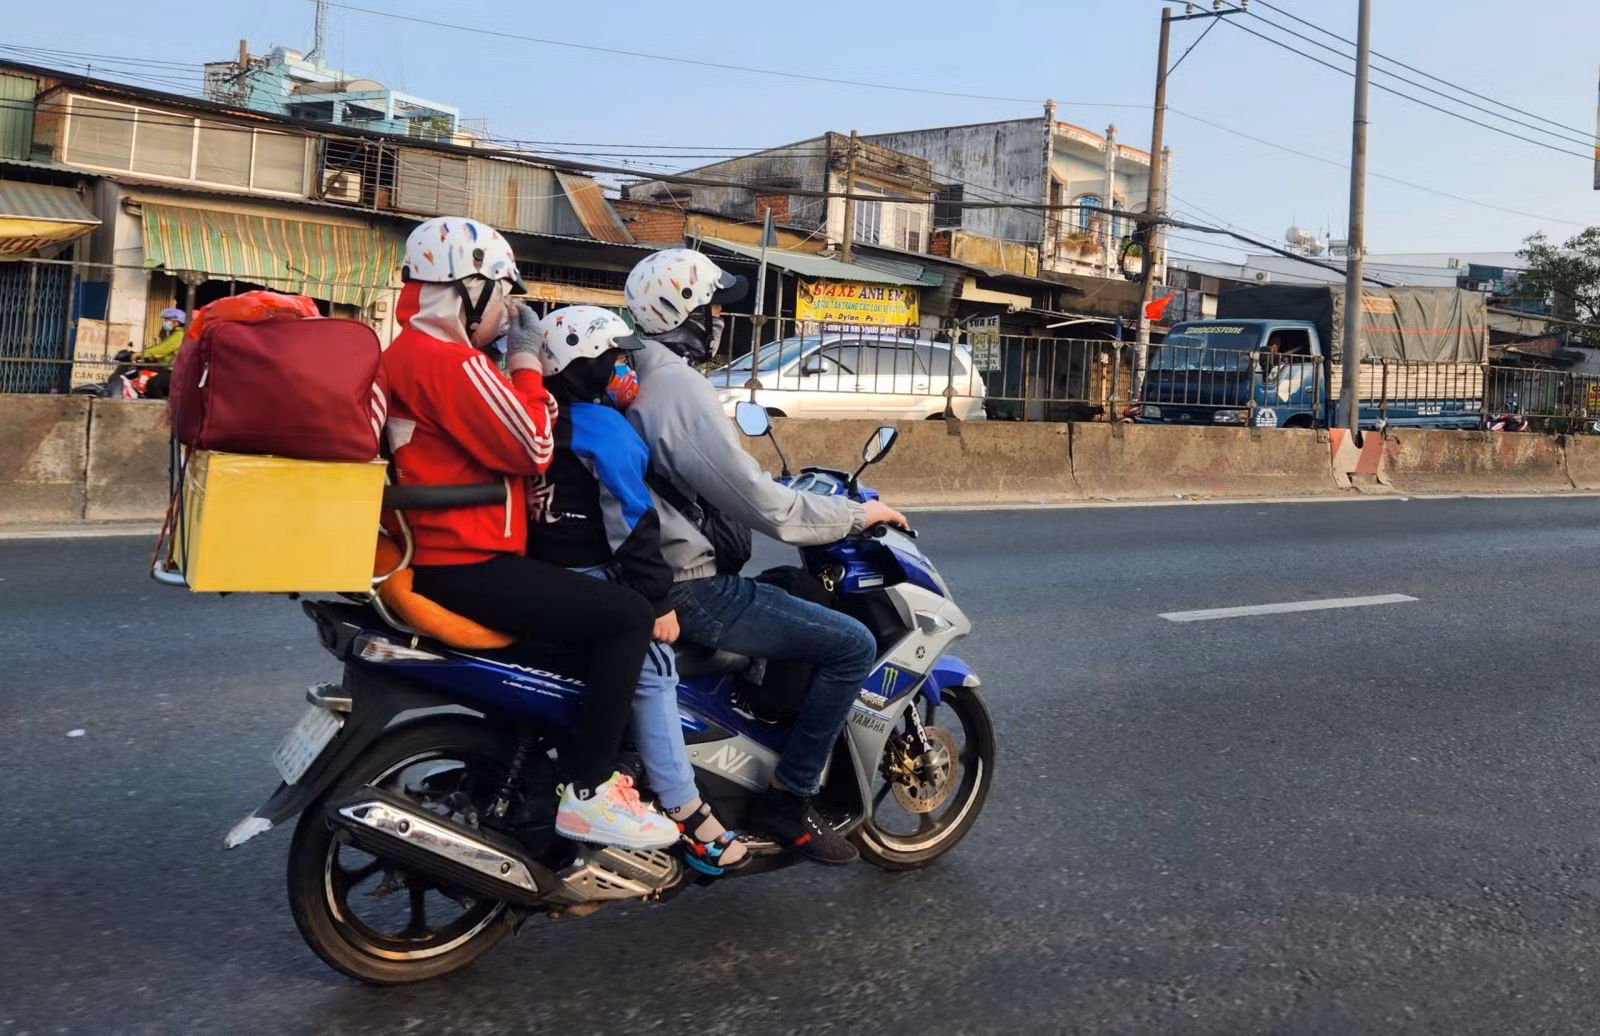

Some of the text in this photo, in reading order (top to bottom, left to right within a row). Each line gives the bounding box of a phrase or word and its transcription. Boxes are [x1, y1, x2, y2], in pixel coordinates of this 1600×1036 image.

[838, 284, 857, 298] XE
[858, 287, 884, 301] ANH
[824, 312, 833, 320] Sh
[838, 313, 859, 321] Dylan
[1184, 326, 1245, 335] BRIDGESTONE
[852, 711, 886, 734] YAMAHA
